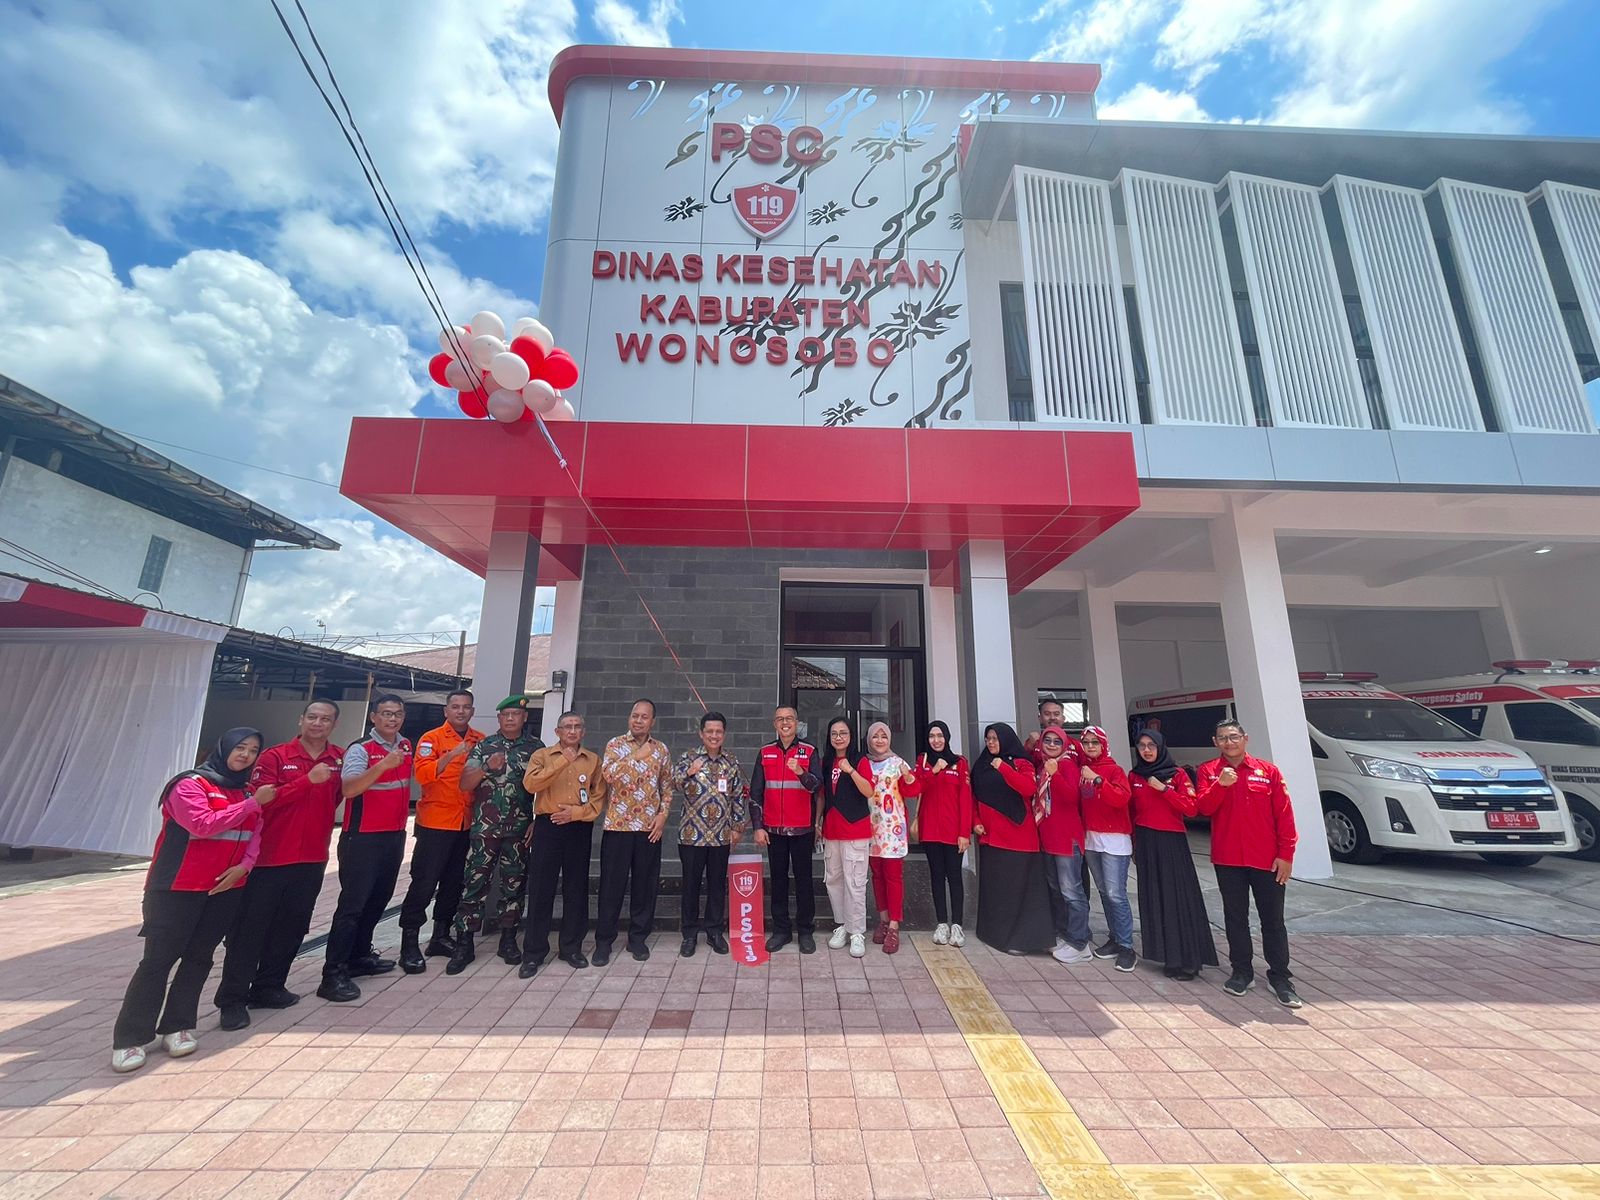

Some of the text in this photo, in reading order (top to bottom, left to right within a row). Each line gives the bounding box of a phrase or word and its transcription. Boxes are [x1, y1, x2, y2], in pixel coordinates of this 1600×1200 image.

[711, 122, 824, 164] PSC
[747, 195, 783, 216] 119
[592, 250, 941, 288] DINAS KESEHATAN
[640, 293, 870, 328] KABUPATEN
[615, 332, 895, 367] WONOSOBO
[1455, 691, 1483, 703] Safety
[739, 876, 753, 886] 119
